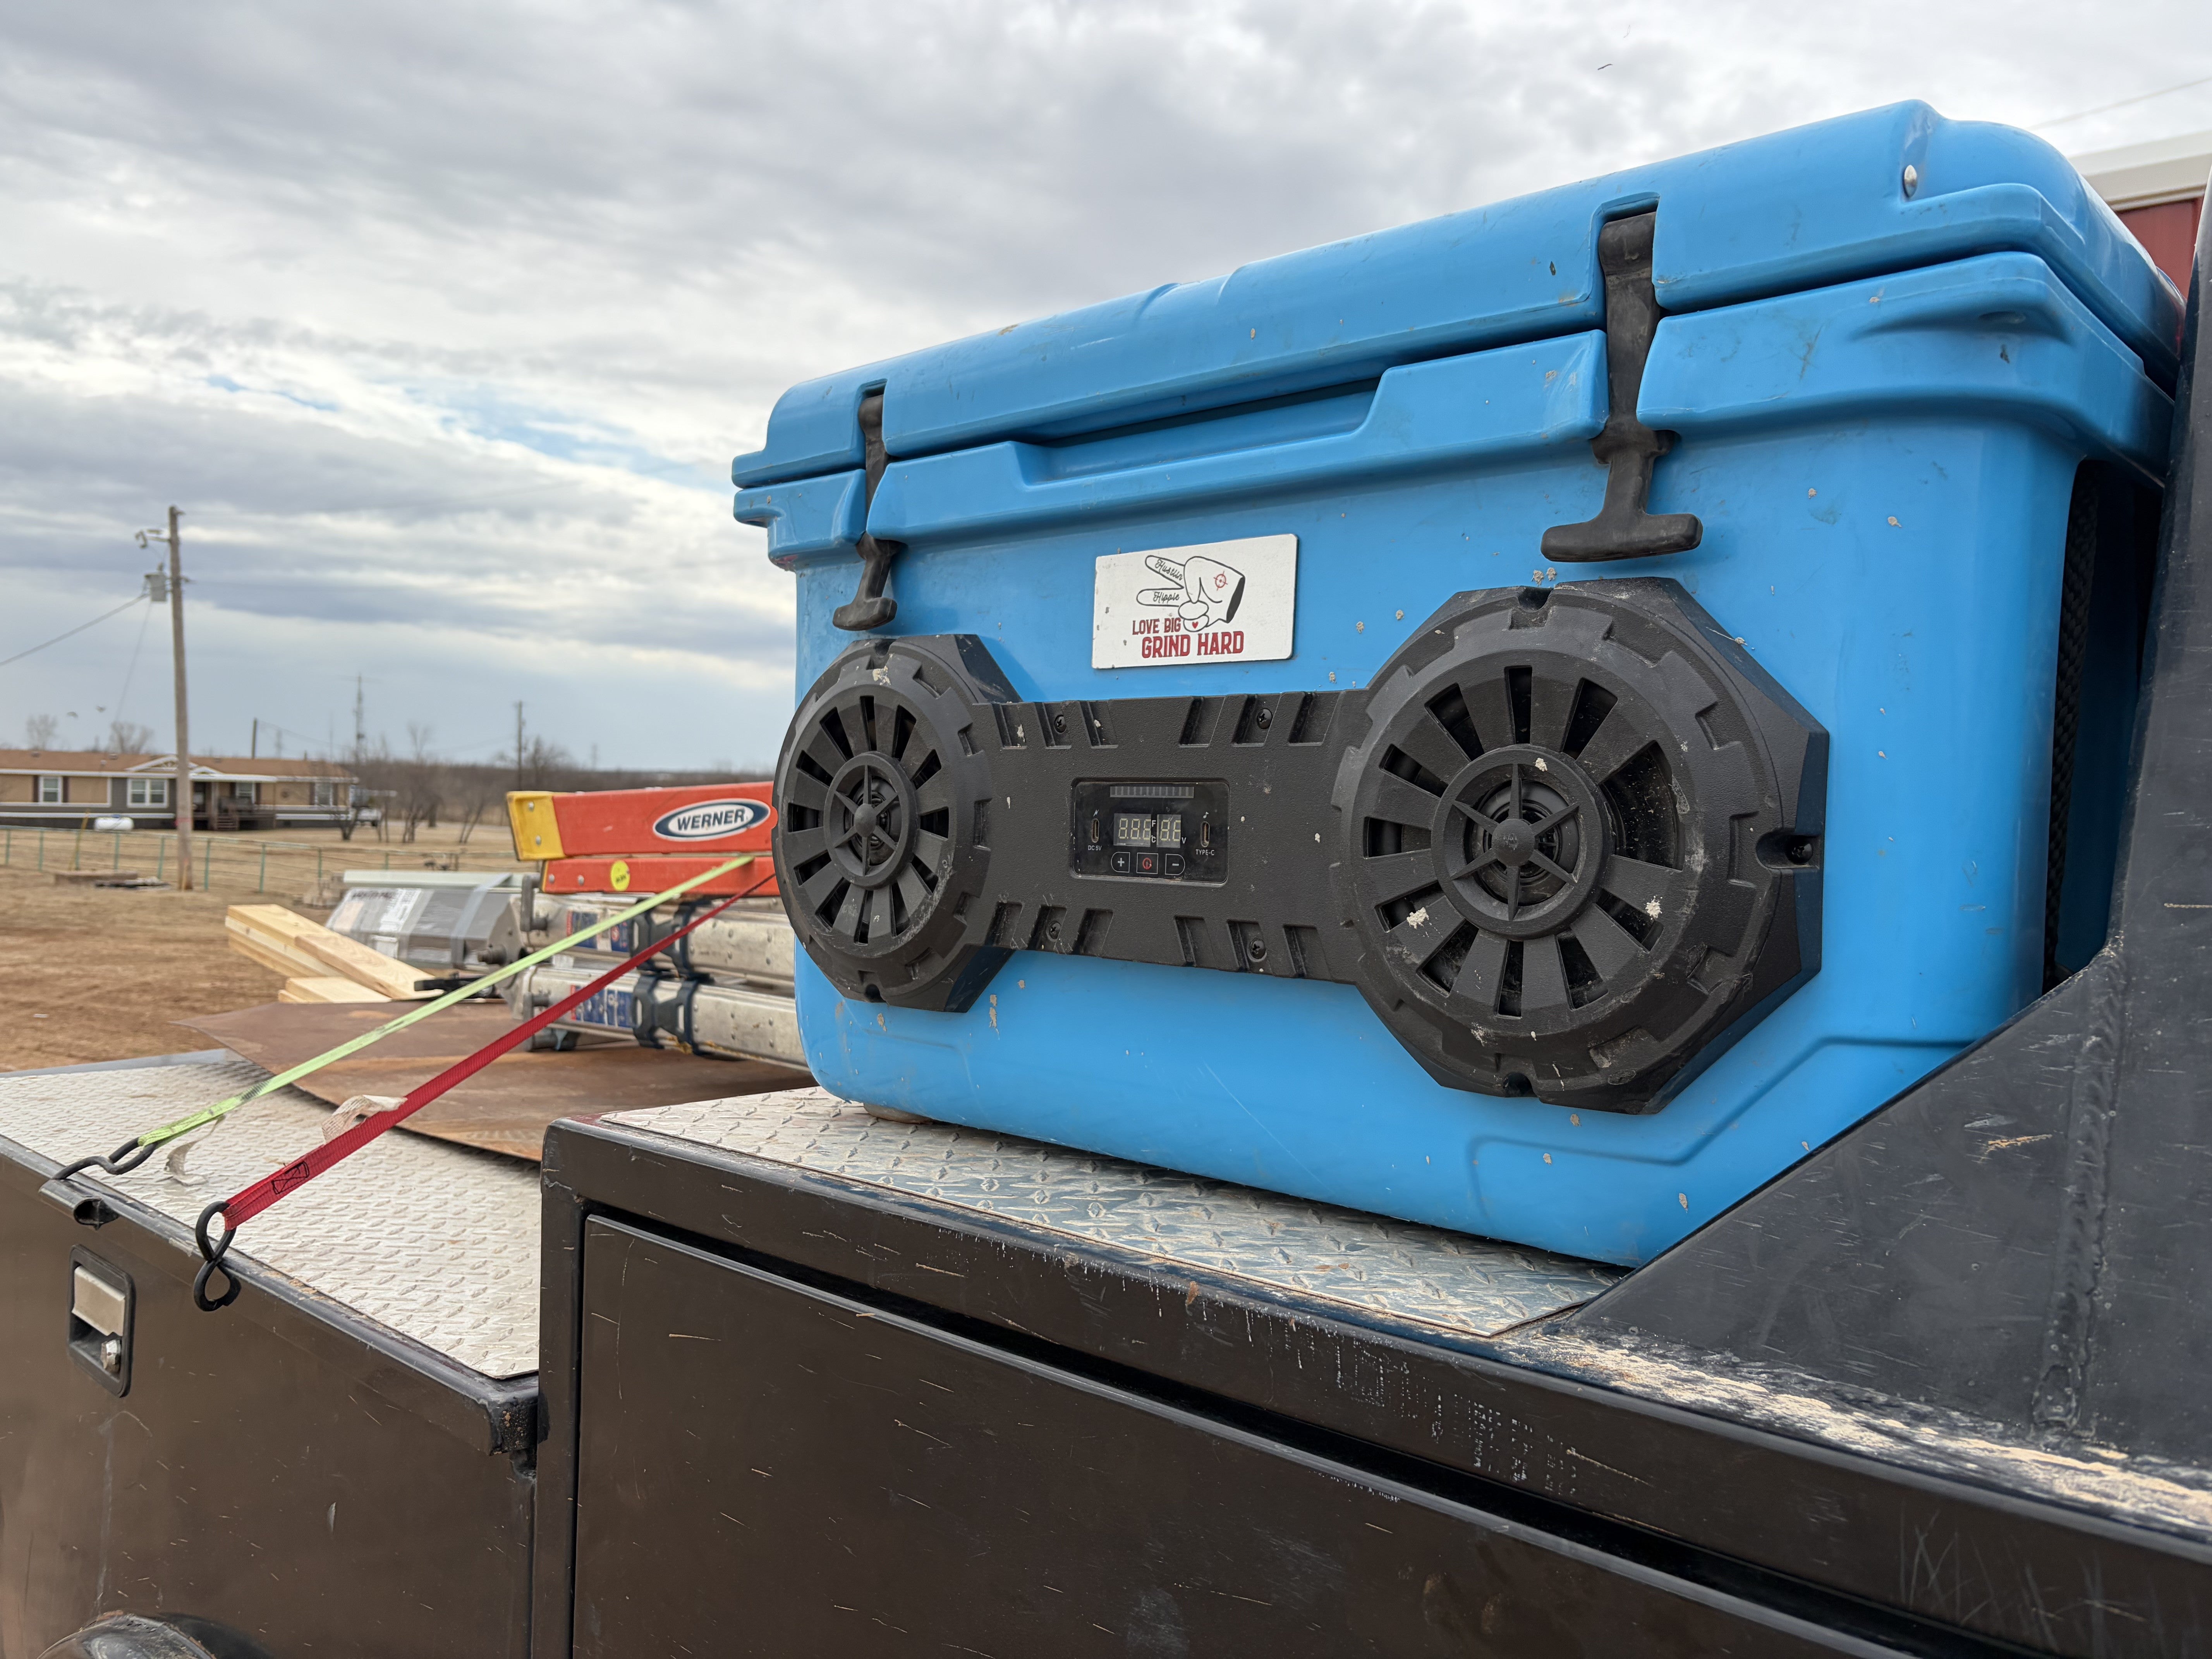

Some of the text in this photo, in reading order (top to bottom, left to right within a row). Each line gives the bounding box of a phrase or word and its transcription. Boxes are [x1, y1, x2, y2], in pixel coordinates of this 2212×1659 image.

[1155, 559, 1182, 580] Hustlin
[1153, 591, 1180, 604] Hippie
[1132, 617, 1181, 635] LOVE BIG
[1142, 631, 1244, 658] GRIND HARD
[678, 808, 745, 831] WERNER
